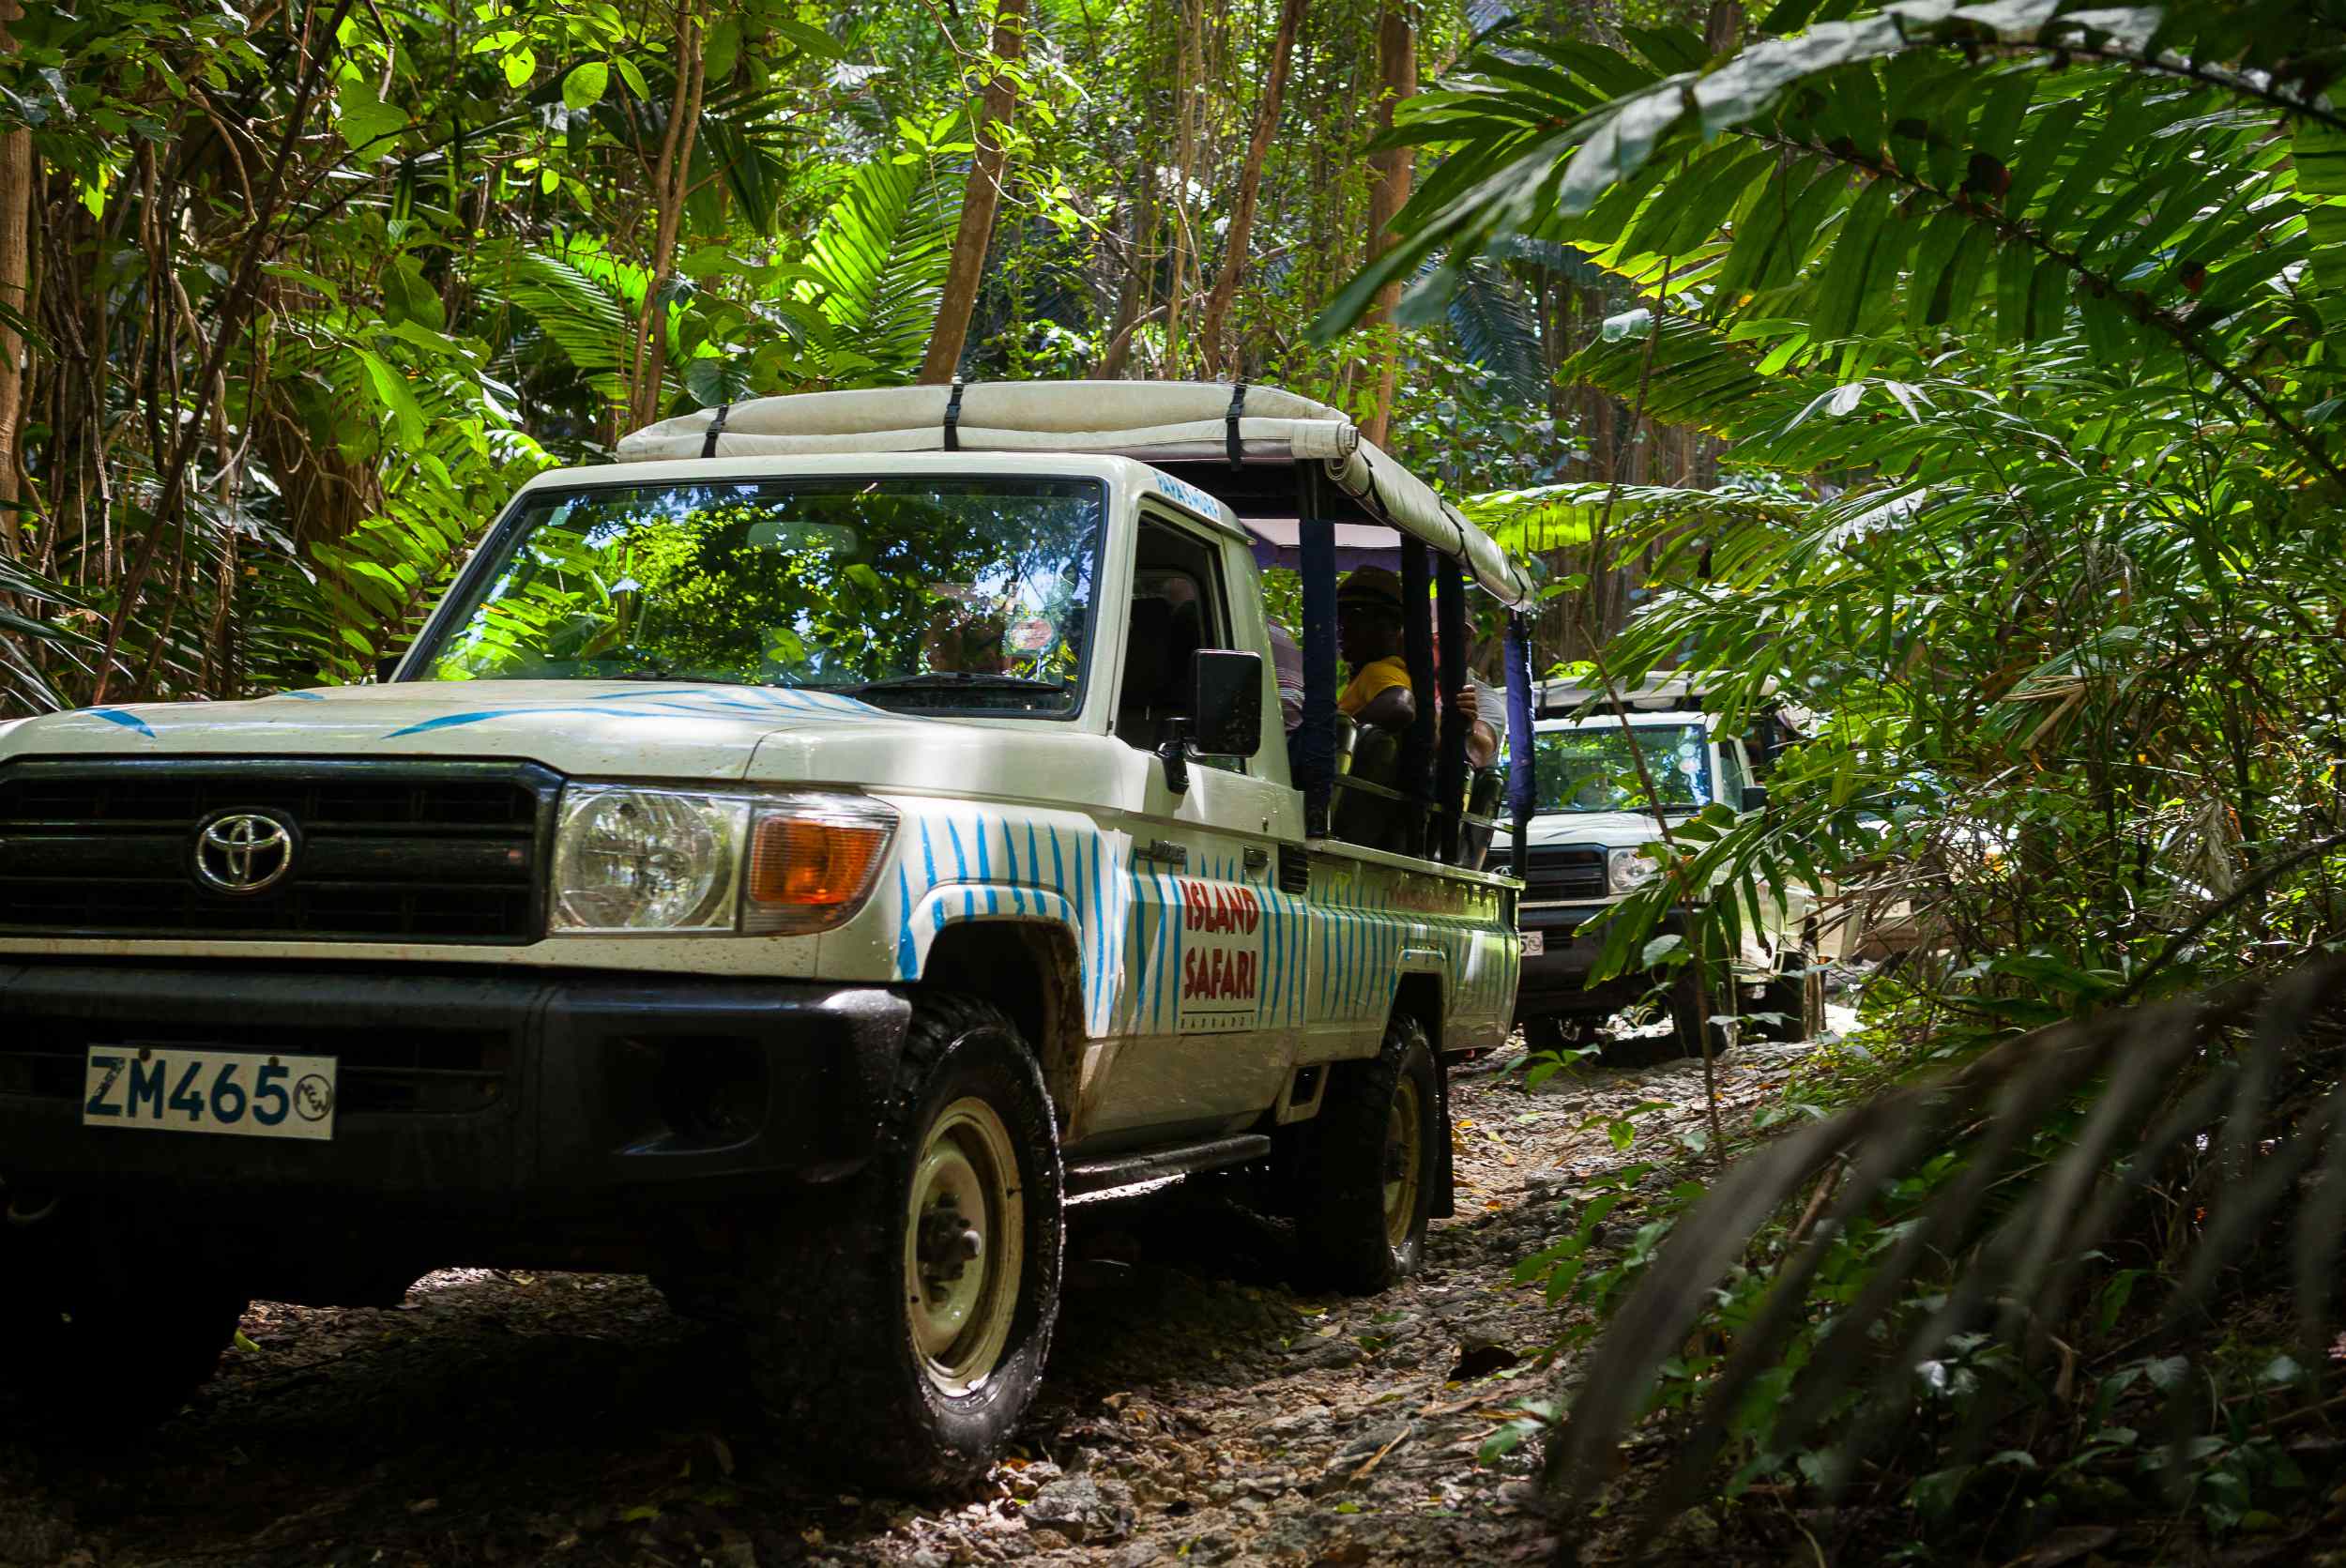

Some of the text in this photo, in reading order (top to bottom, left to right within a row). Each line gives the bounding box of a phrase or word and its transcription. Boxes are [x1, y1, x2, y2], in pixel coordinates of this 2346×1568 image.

[1179, 880, 1259, 935] ISLAND
[1184, 947, 1257, 1000] SAFARI
[85, 1056, 289, 1125] ZM465
